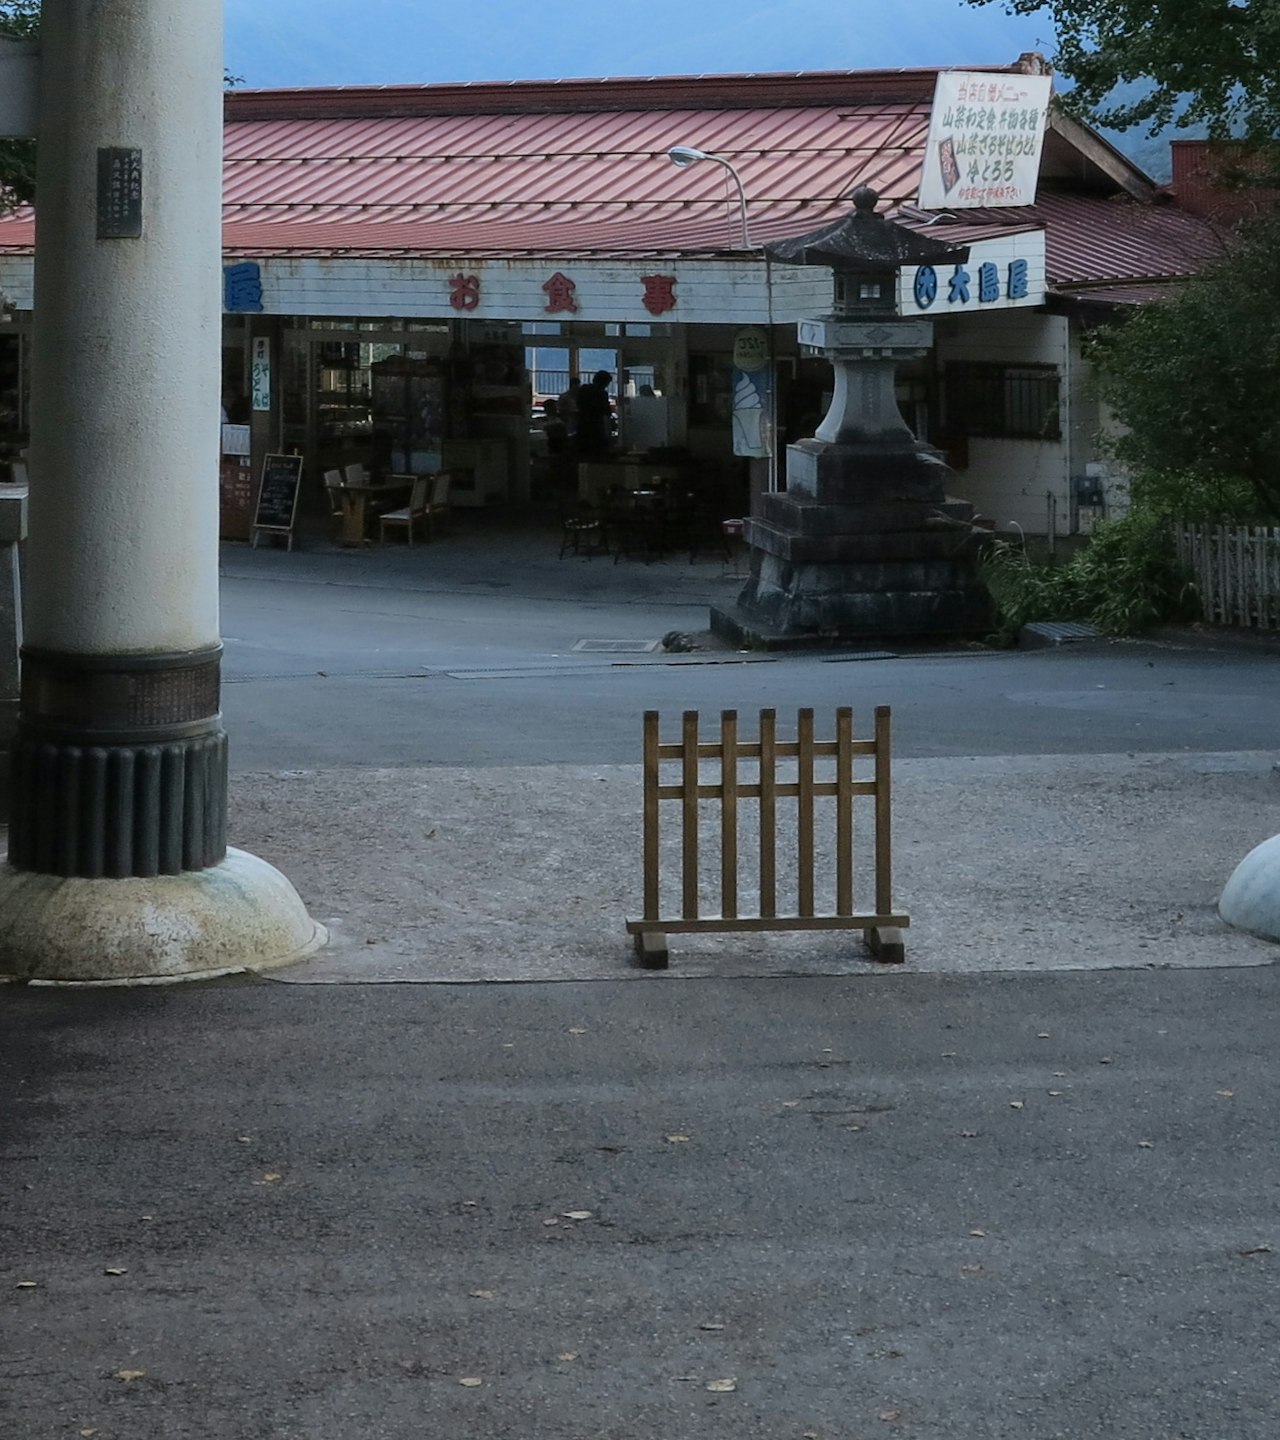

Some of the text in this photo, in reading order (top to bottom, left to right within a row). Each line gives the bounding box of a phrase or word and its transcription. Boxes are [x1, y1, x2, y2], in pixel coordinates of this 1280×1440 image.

[966, 158, 1015, 184] 冷とろろ
[447, 270, 679, 316] お食事
